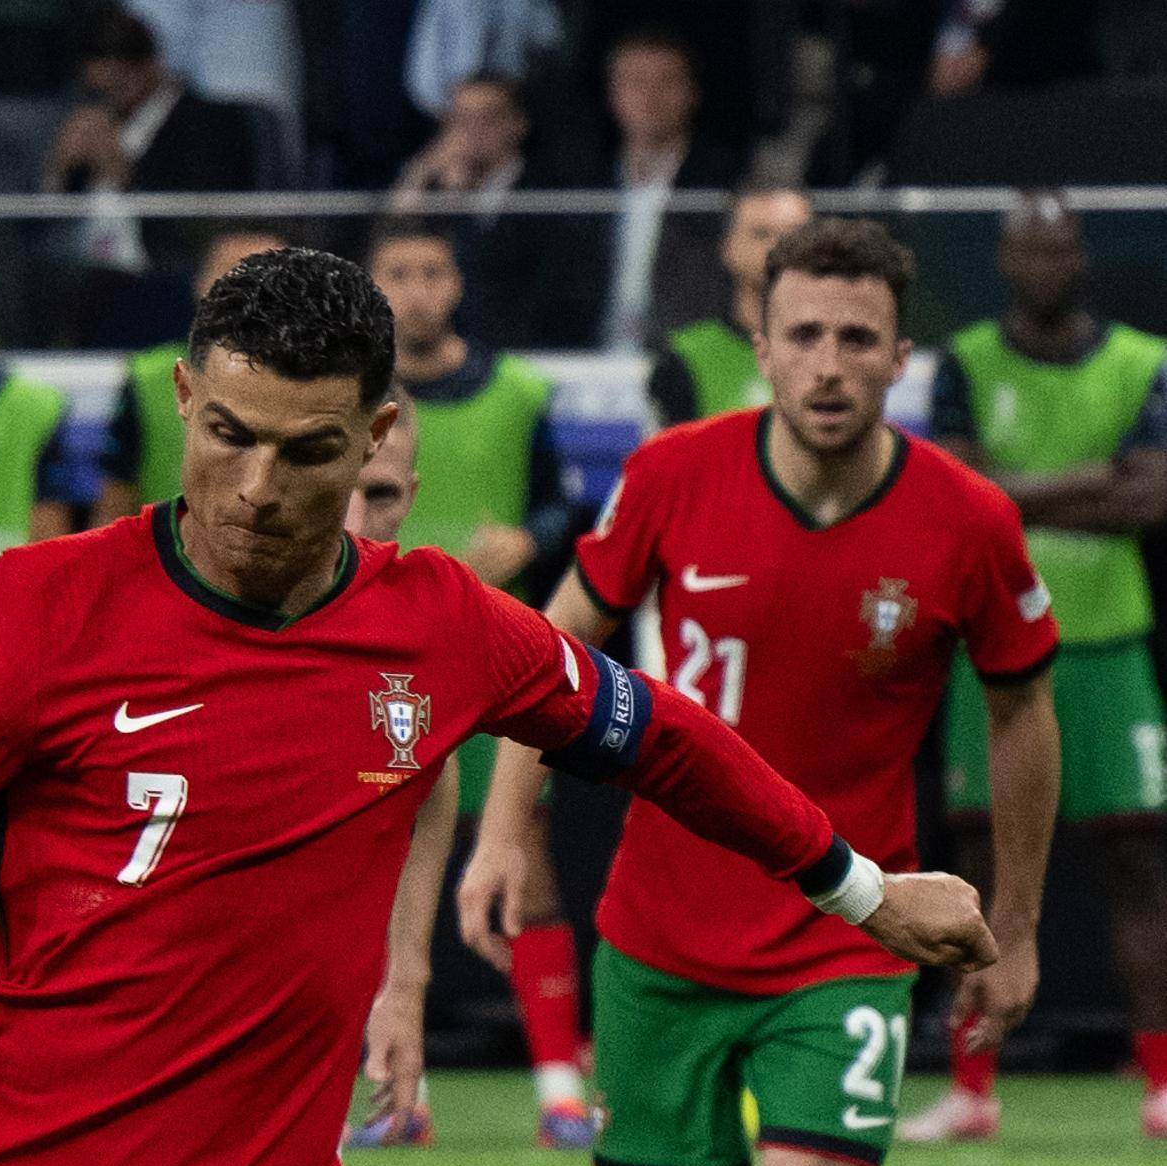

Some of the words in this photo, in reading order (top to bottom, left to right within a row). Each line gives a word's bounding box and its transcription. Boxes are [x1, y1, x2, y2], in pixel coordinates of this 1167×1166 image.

[675, 617, 748, 727] 21
[116, 771, 189, 888] 7
[842, 1005, 907, 1106] 21
